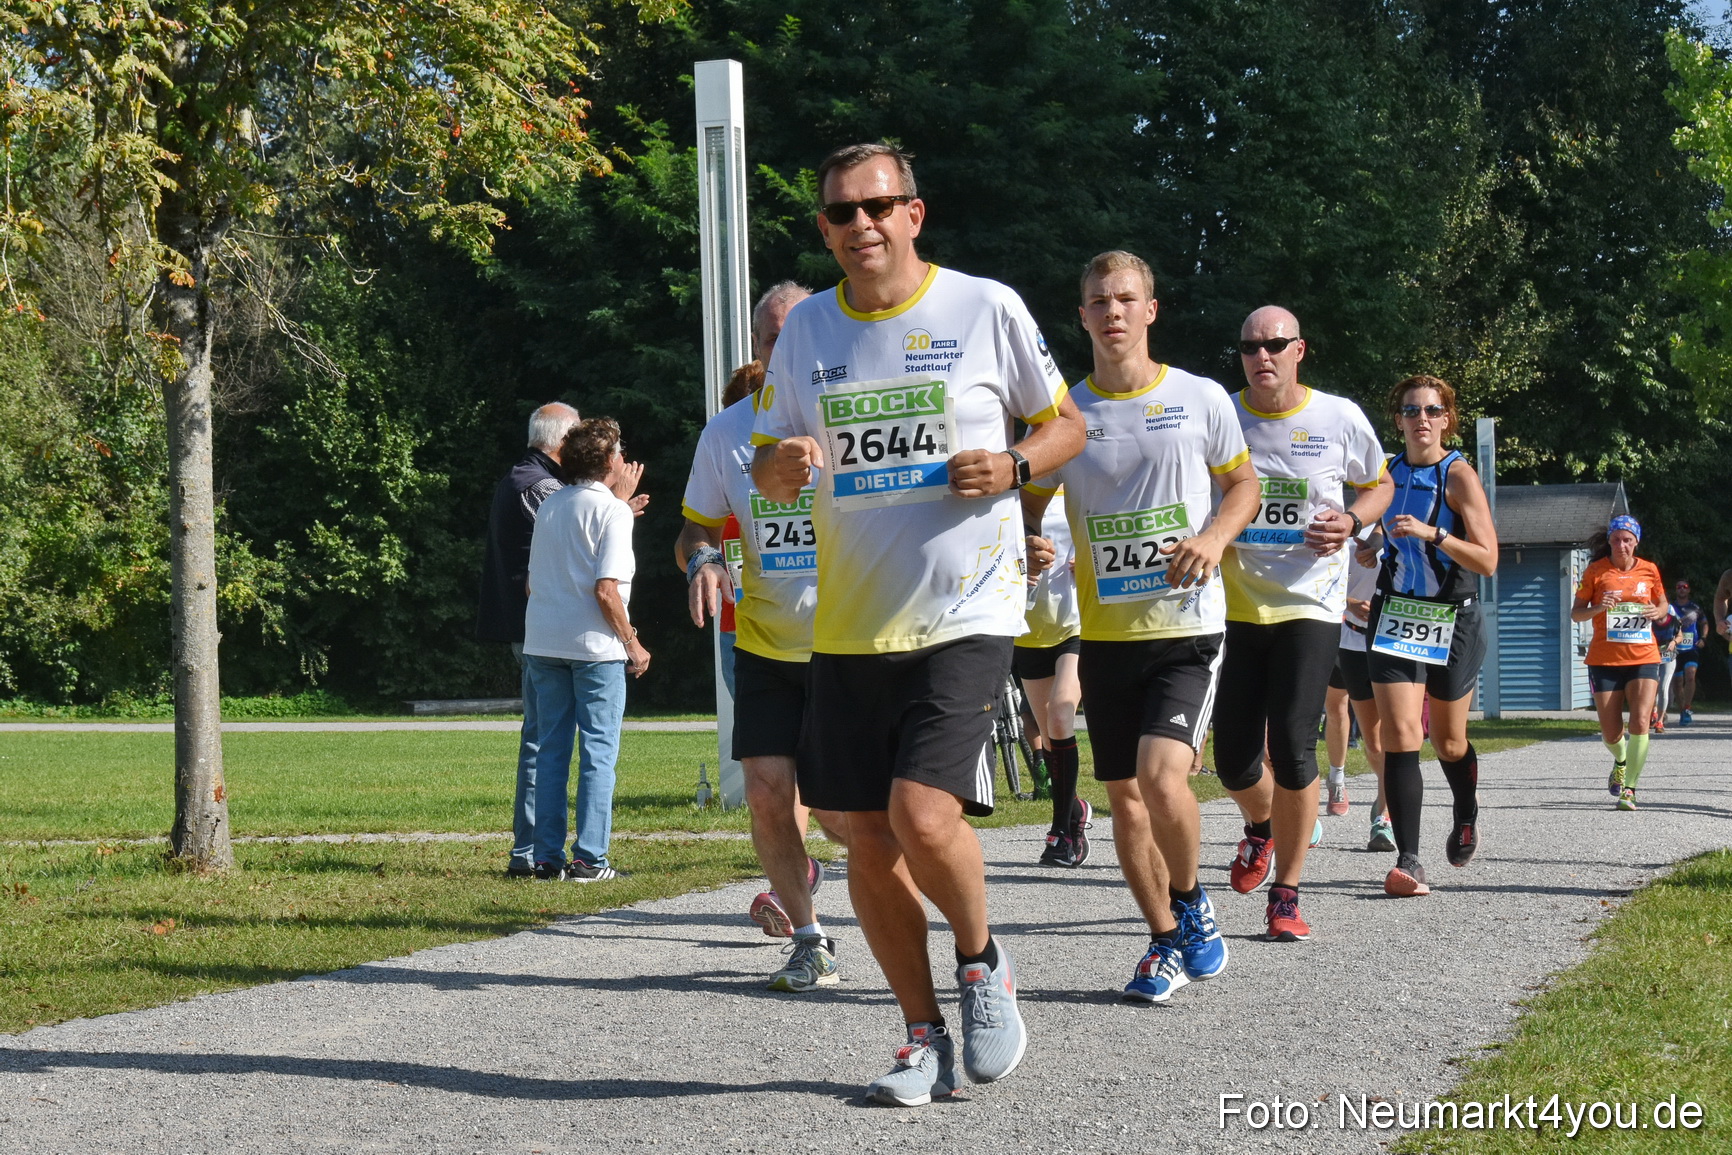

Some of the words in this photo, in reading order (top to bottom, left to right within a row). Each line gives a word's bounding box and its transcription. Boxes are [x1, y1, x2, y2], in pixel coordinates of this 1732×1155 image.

[905, 334, 930, 350] 20
[933, 340, 956, 349] JAHRE
[905, 351, 964, 362] Neumarkter
[812, 365, 847, 381] BOCK
[905, 363, 952, 373] Stadtlauf
[827, 386, 937, 423] BOCK
[1145, 404, 1164, 416] 20
[1145, 414, 1189, 424] Neumarkter
[1087, 429, 1104, 438] CK
[1146, 422, 1181, 432] Stadtlauf
[1292, 431, 1308, 442] 20
[837, 423, 936, 466] 2644
[854, 469, 924, 491] DIETER
[1260, 480, 1300, 497] CK
[758, 494, 815, 515] BOC
[1249, 503, 1299, 525] 766
[1093, 507, 1181, 538] BOCK
[765, 520, 817, 548] 243
[1239, 531, 1292, 543] MICHAEL
[775, 555, 817, 568] MARTI
[966, 563, 998, 598] September
[1388, 600, 1448, 620] BOCK
[1613, 617, 1647, 628] 2272
[1385, 619, 1443, 643] 2591
[1393, 642, 1429, 656] SILVIA
[967, 969, 982, 977] NIKE
[913, 1028, 927, 1036] NIKE
